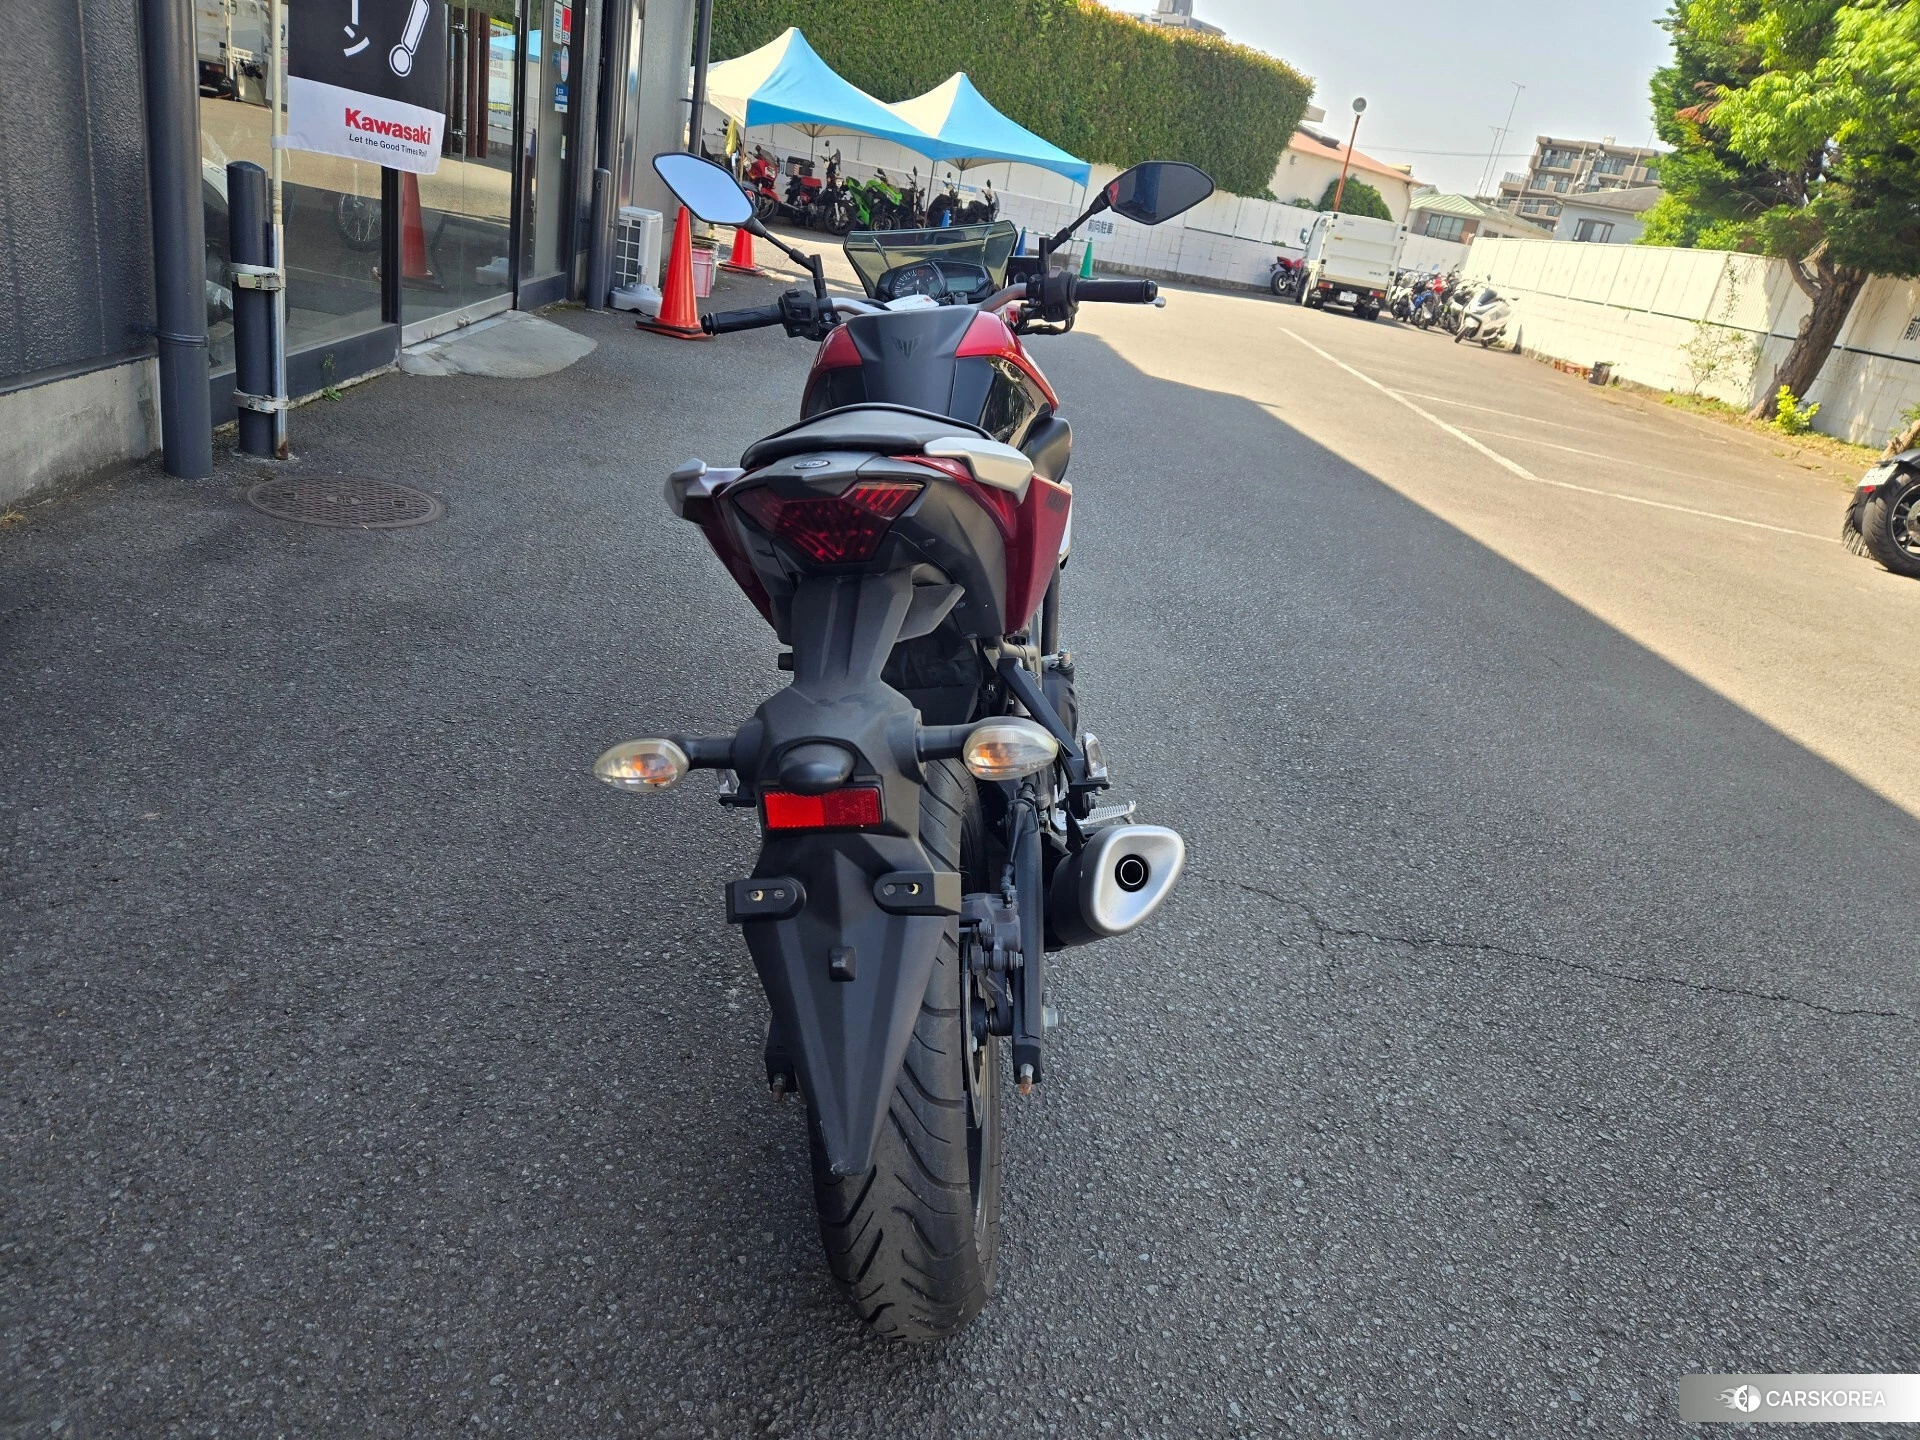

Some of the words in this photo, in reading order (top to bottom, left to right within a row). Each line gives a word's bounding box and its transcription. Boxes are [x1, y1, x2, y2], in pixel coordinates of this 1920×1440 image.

[345, 107, 431, 145] Kawasaki
[349, 133, 363, 144] Let
[365, 137, 379, 147] the
[380, 140, 400, 152] Good
[401, 144, 418, 156] Times
